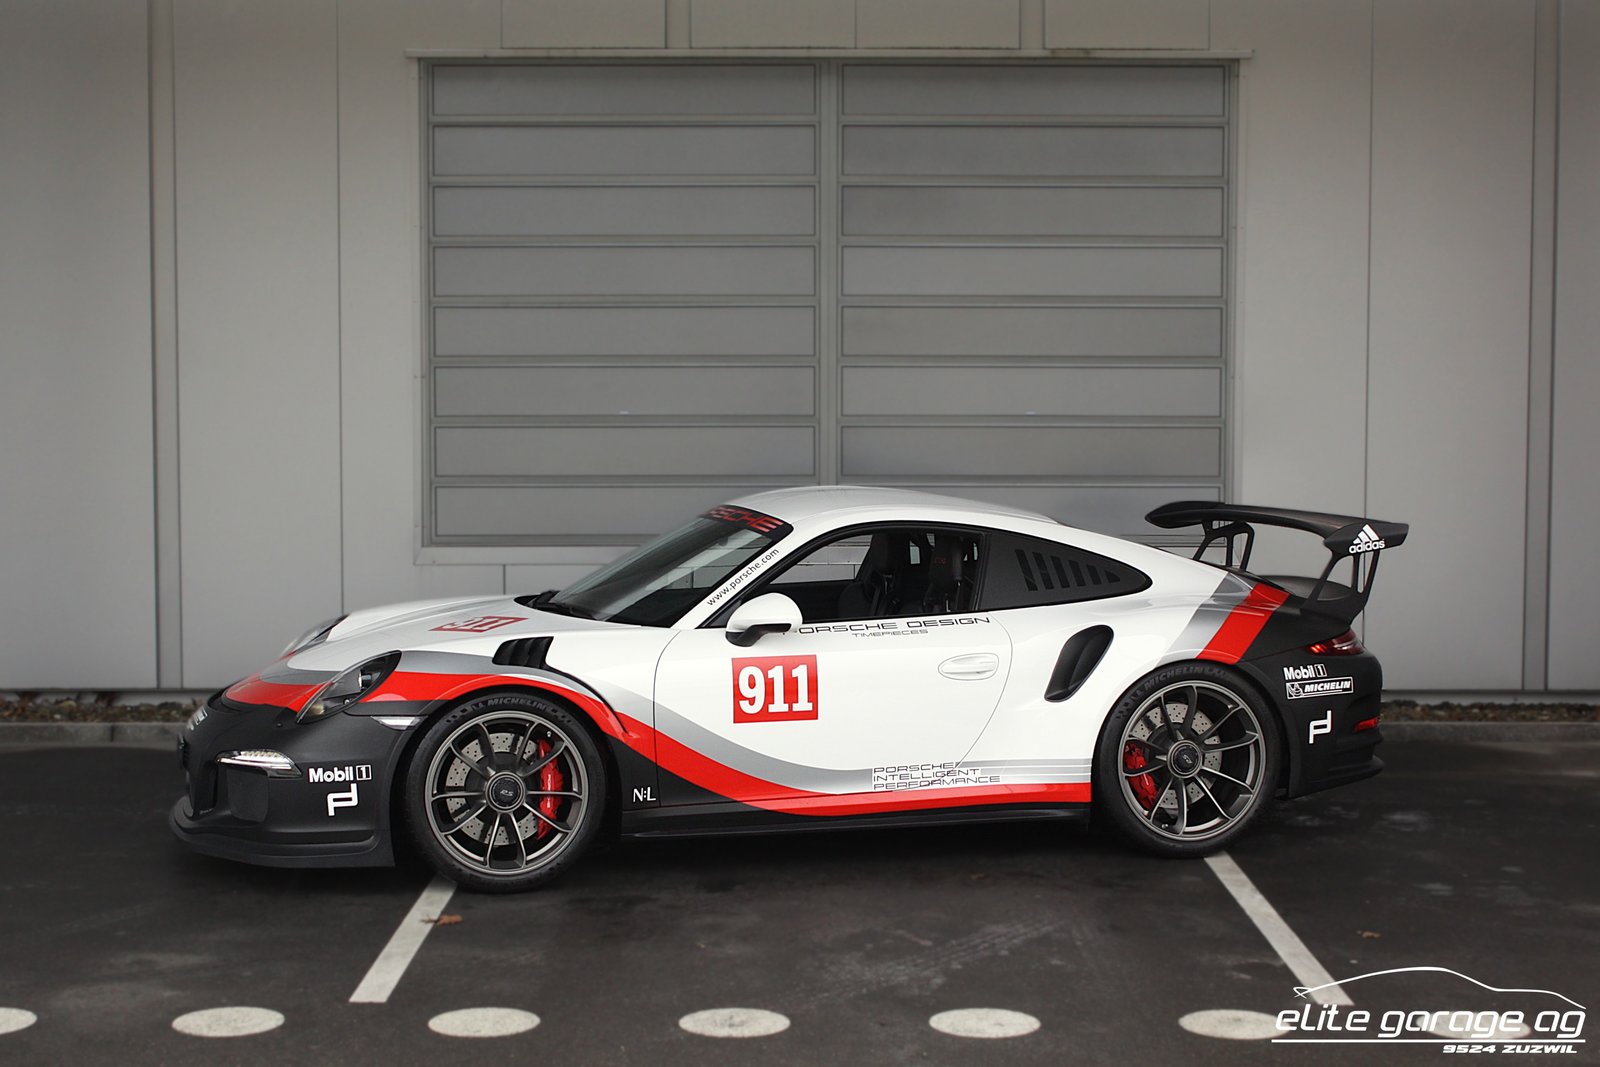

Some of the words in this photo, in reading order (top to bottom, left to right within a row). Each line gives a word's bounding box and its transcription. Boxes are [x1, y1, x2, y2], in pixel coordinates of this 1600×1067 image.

[1349, 539, 1385, 553] adidas
[707, 549, 780, 606] www.porsche.com
[792, 622, 898, 635] ORSCHE
[907, 617, 990, 629] DESIGN
[852, 630, 929, 638] TIMEPIECES
[1283, 665, 1316, 681] Mobil
[738, 664, 813, 714] 911
[1304, 681, 1351, 692] MICHELIN
[487, 697, 547, 710] MICHELIN
[308, 766, 354, 783] Mobil
[873, 761, 954, 774] PORSCHE
[873, 768, 980, 782] INTELLIGENT
[873, 775, 1001, 790] PERFORMANCE
